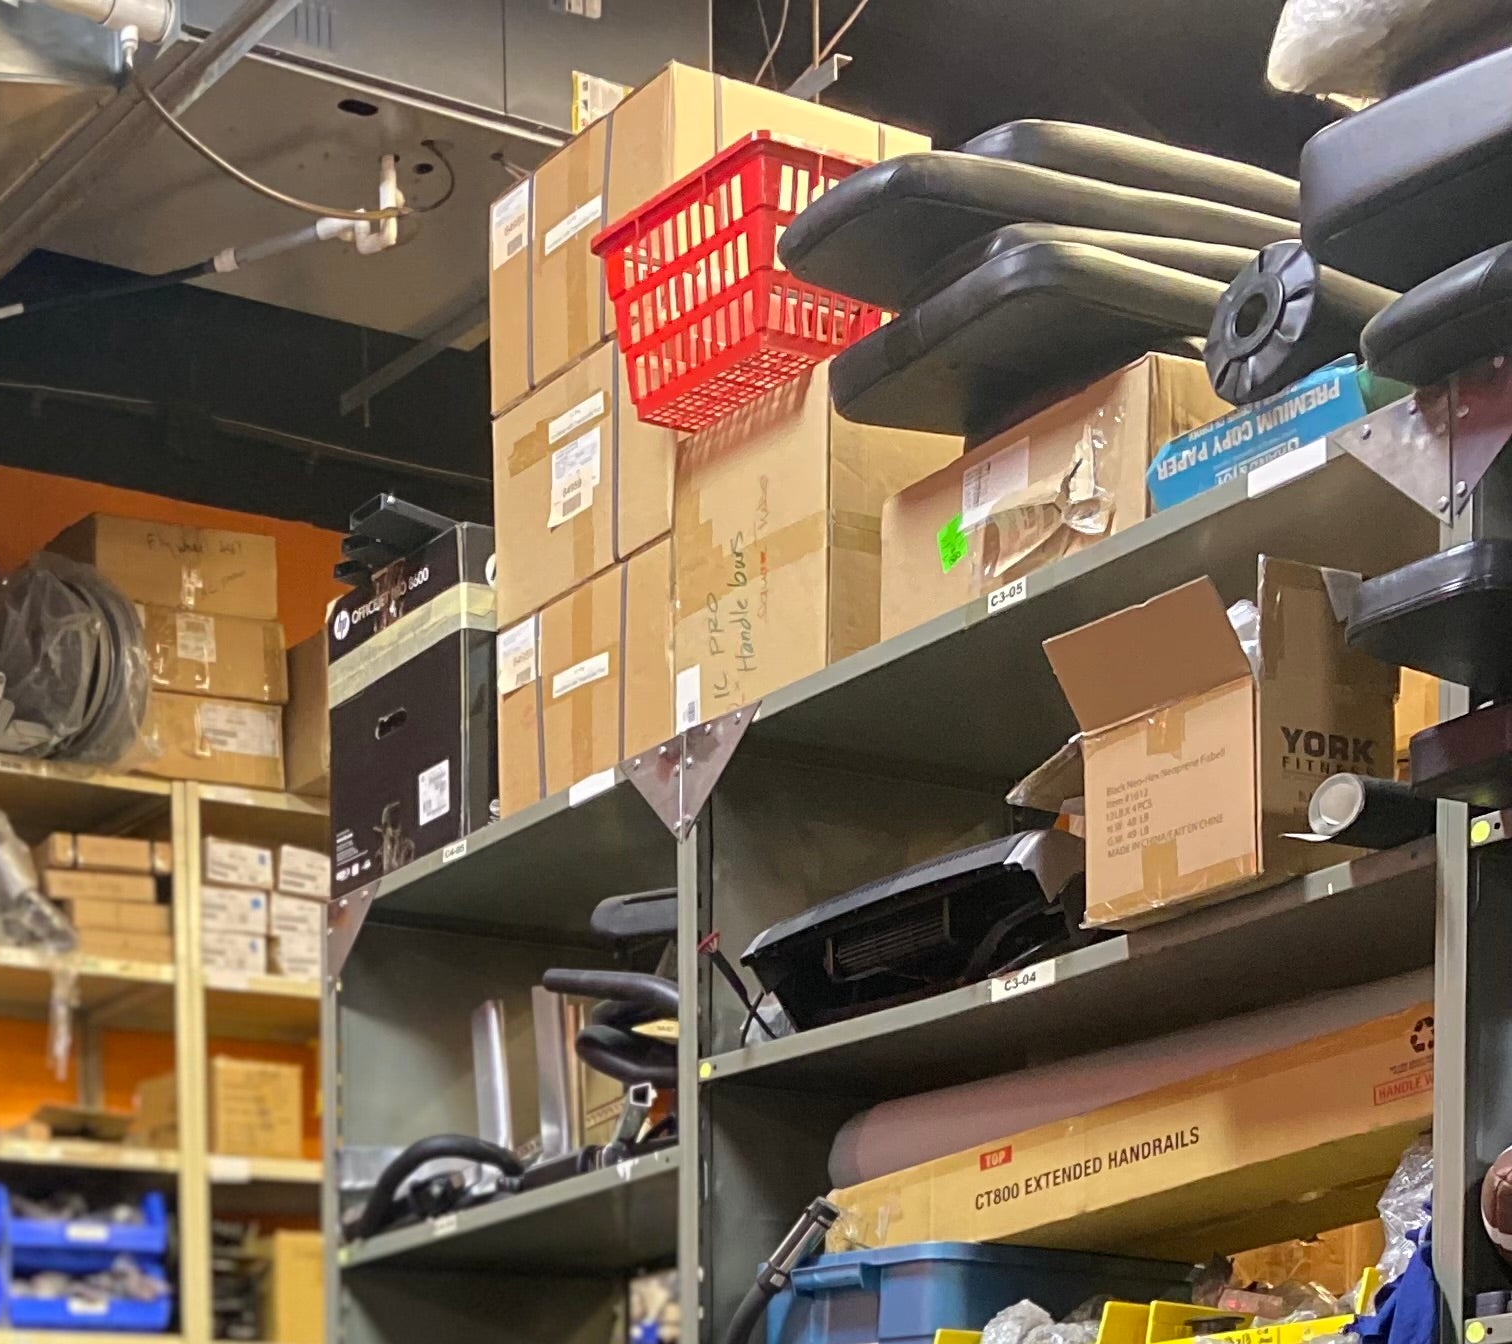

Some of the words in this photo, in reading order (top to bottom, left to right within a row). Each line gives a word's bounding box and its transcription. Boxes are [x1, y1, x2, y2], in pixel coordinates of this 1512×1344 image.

[1257, 377, 1340, 434] PREMIUM
[1212, 420, 1254, 456] COPY
[1157, 441, 1209, 481] PAPER
[408, 566, 430, 590] 8600
[990, 582, 1023, 607] C3-05
[706, 591, 725, 657] PRO
[730, 598, 757, 673] Handle
[1280, 725, 1374, 764] YORK
[1108, 844, 1130, 858] MADE
[1132, 841, 1140, 851] IN
[1004, 971, 1037, 991] C3-04
[1378, 1077, 1421, 1099] HANDLE
[975, 1182, 1020, 1210] CT800
[1024, 1156, 1102, 1195] EXTENDED
[1108, 1126, 1200, 1169] HANDRAILS
[984, 1149, 1006, 1167] TOP
